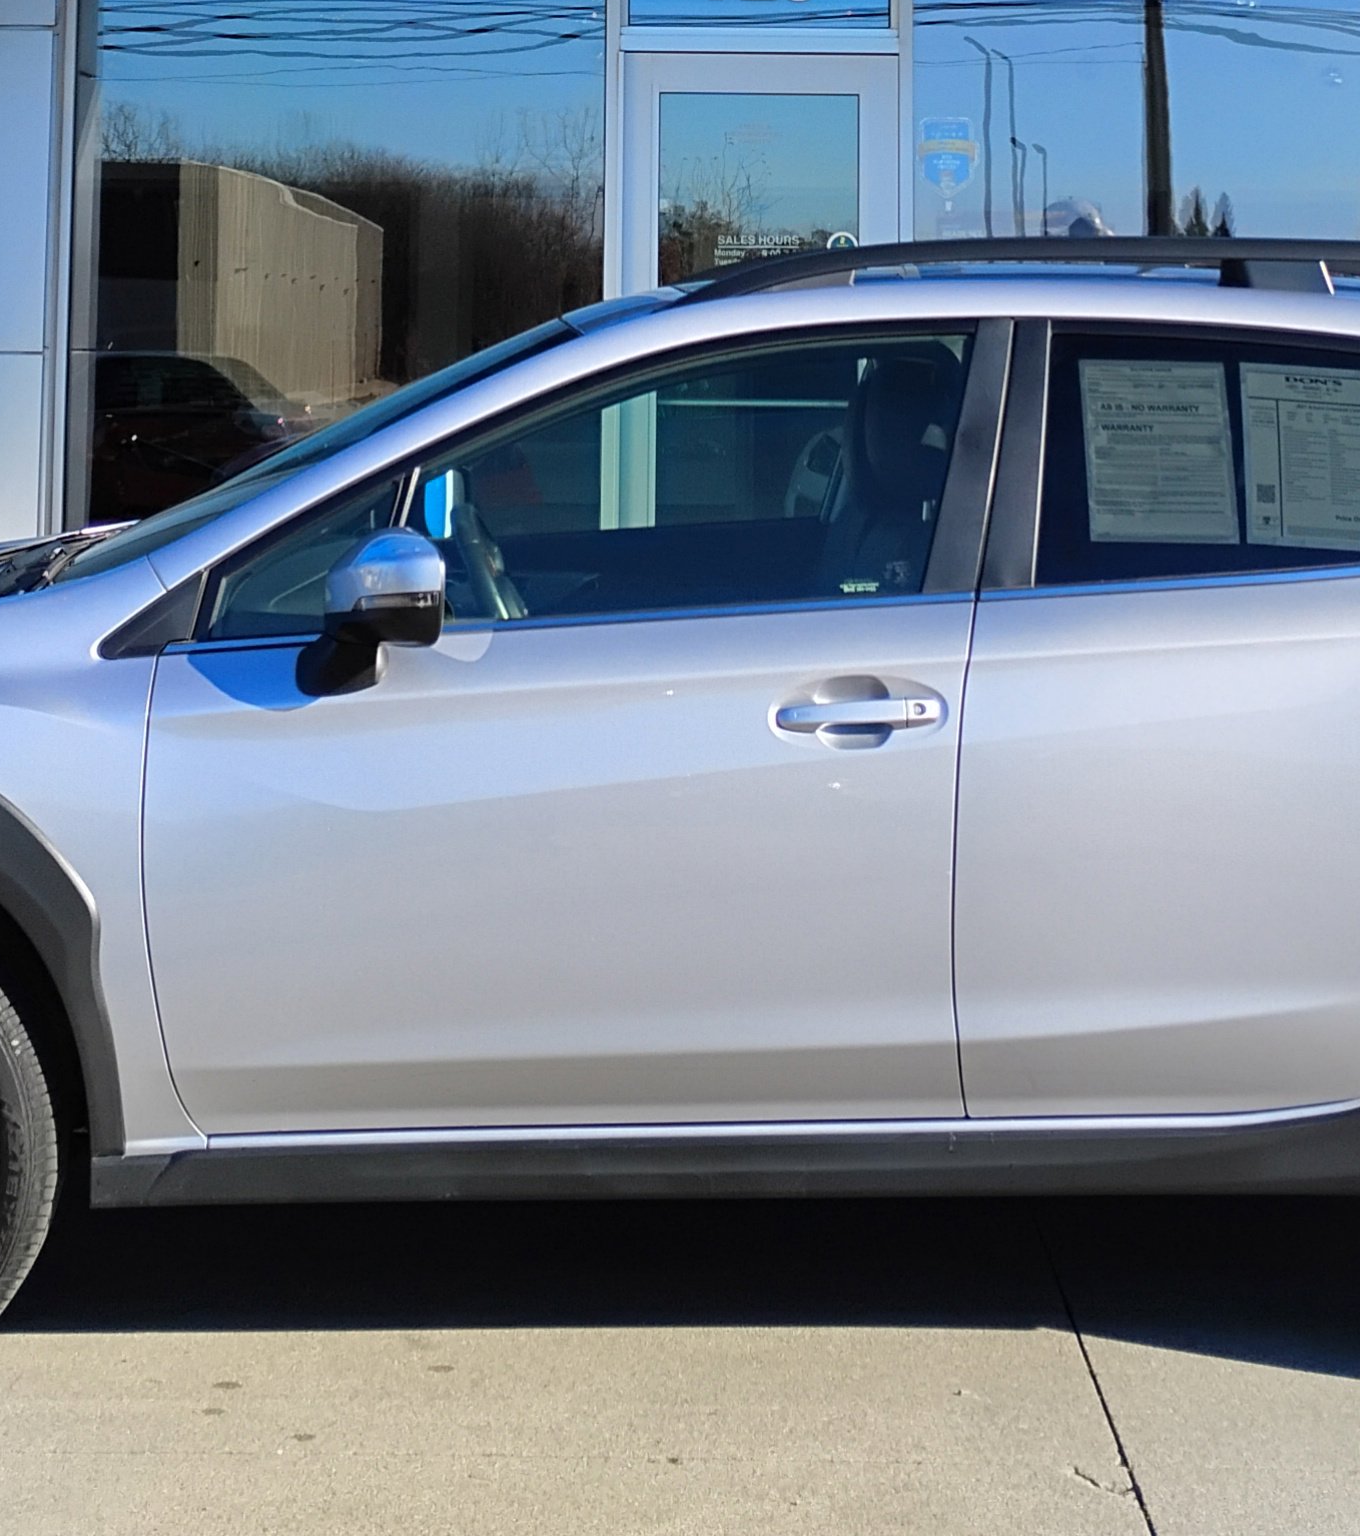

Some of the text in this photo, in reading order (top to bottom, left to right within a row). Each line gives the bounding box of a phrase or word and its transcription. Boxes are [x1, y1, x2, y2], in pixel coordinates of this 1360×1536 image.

[717, 235, 800, 245] SALES HOURS
[714, 248, 745, 258] Monday
[1284, 376, 1343, 386] DON'S
[1100, 403, 1113, 411] AS
[1131, 404, 1145, 412] NO
[1146, 404, 1200, 413] WARRANTY
[1100, 424, 1155, 432] WARRANTY
